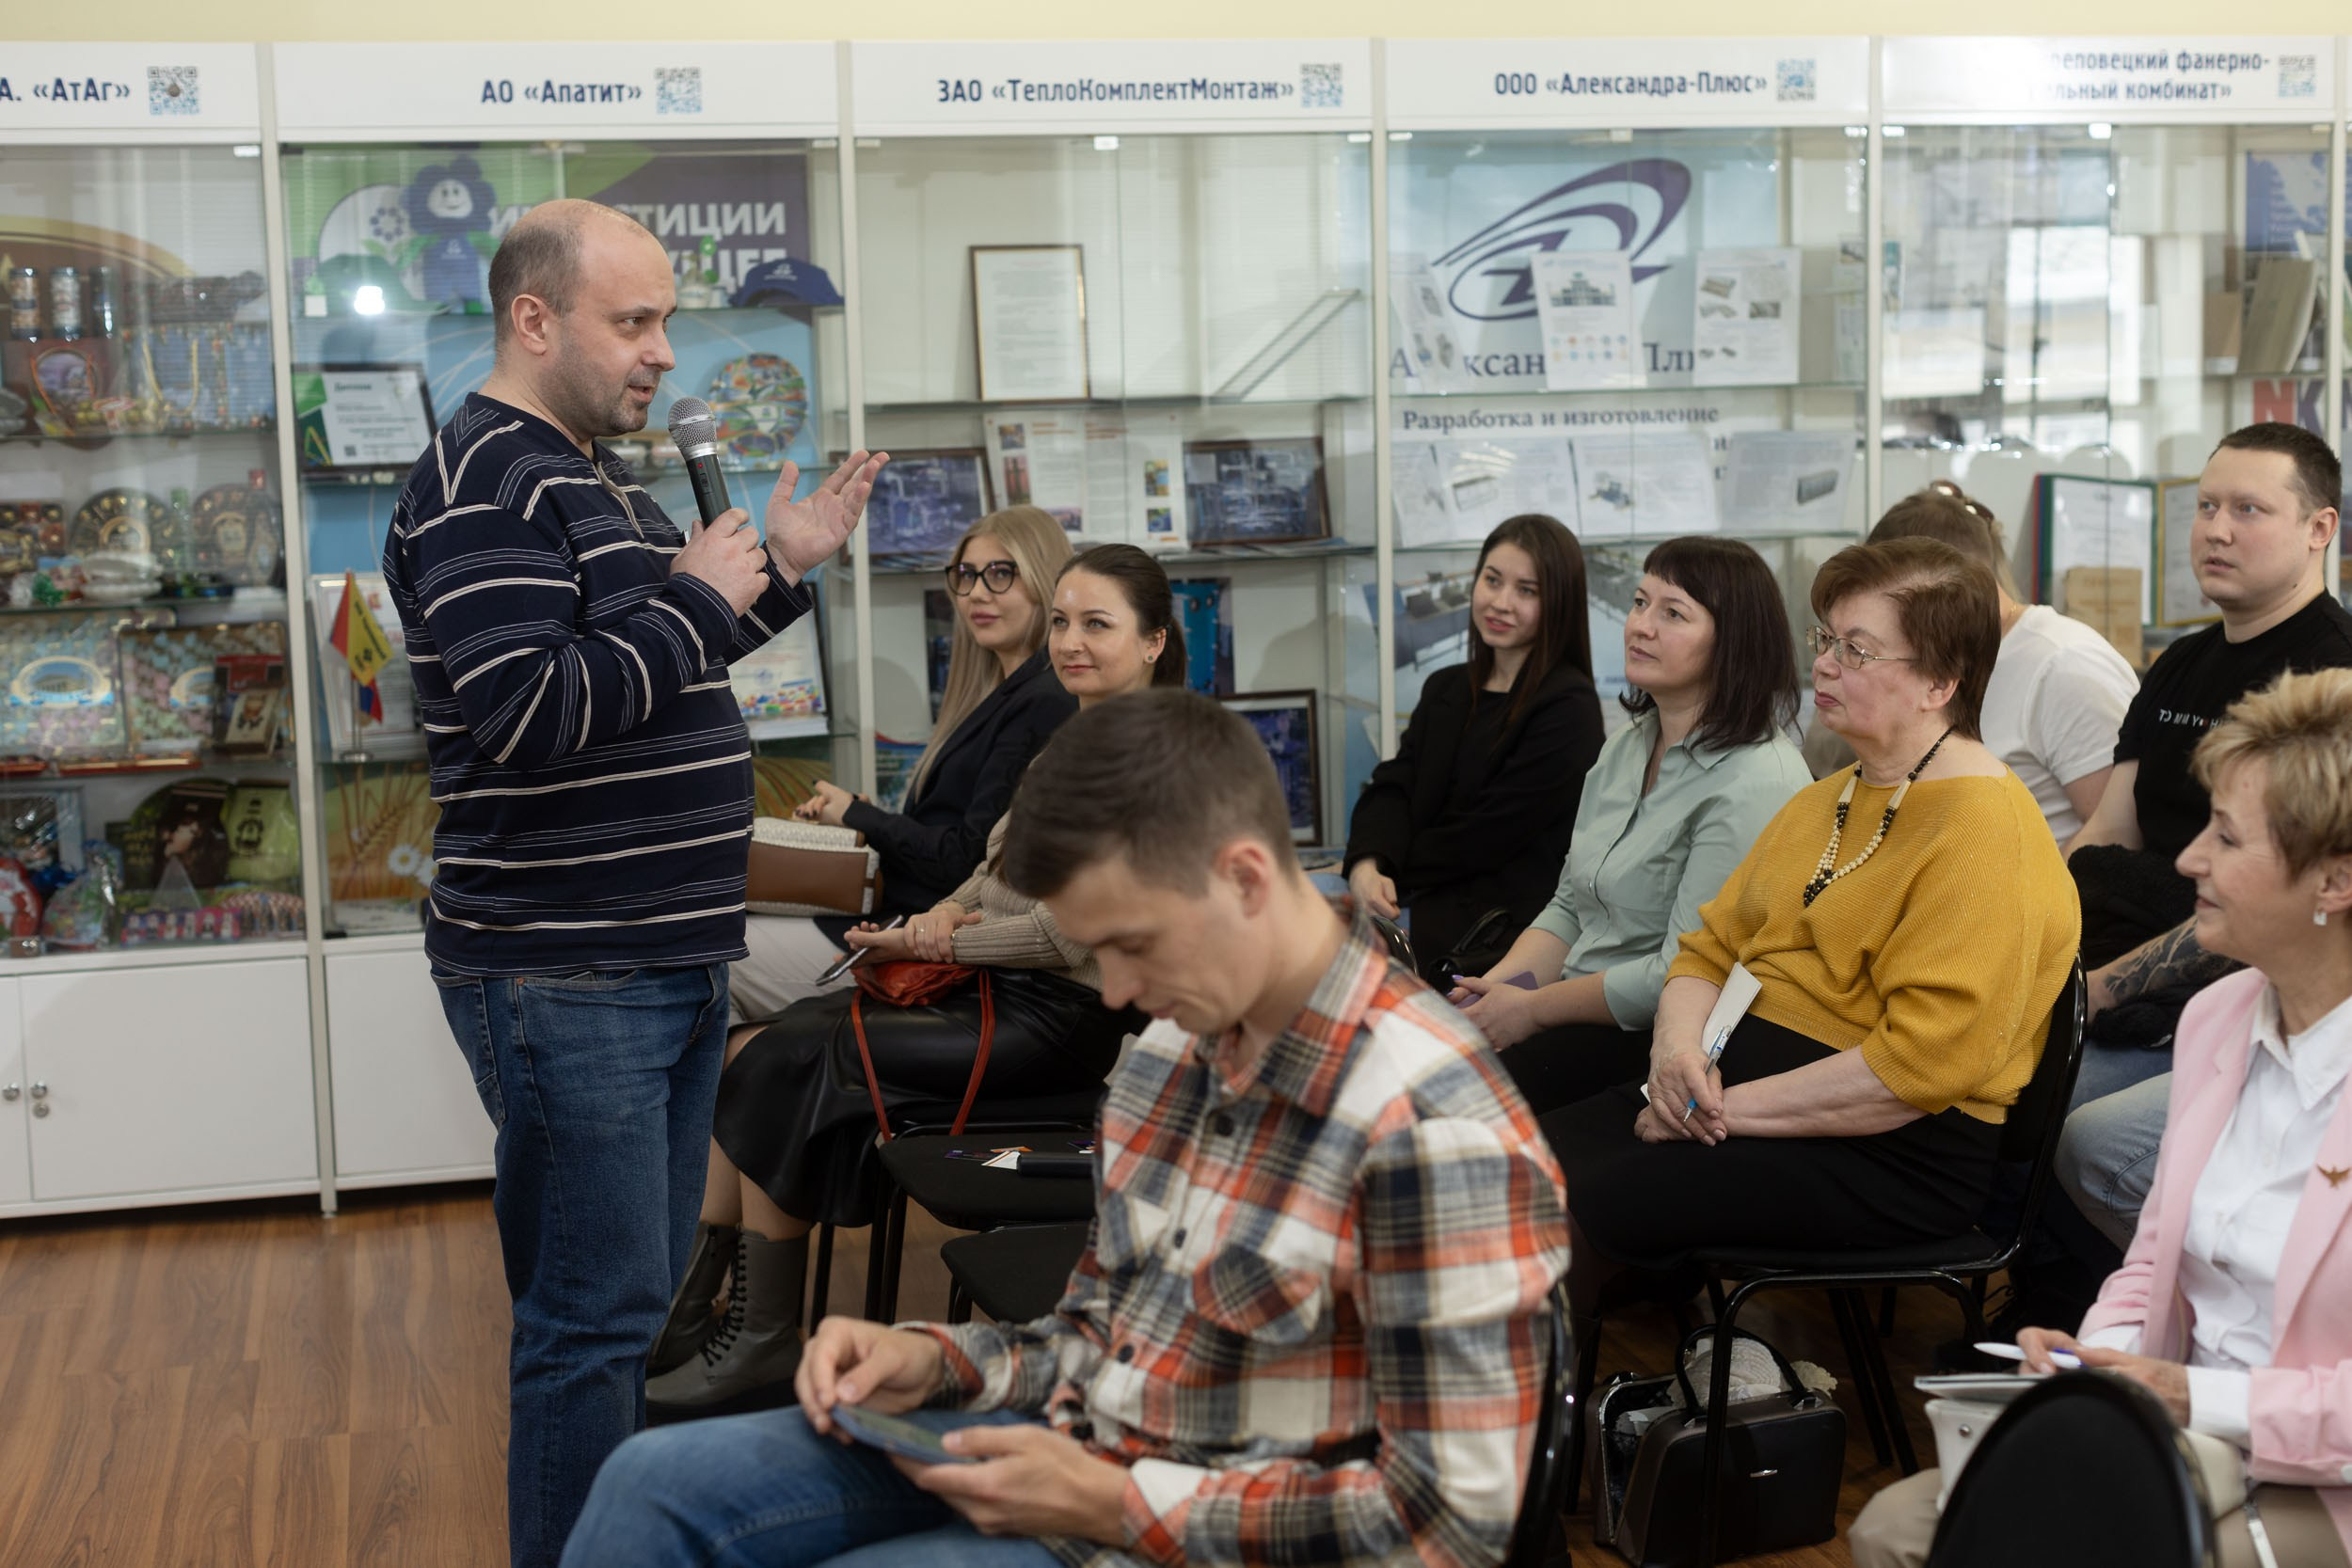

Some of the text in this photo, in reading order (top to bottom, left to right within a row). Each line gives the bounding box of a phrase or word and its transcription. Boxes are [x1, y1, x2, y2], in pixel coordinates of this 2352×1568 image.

[2051, 49, 2269, 72] еповецкий фанерно-
[33, 77, 130, 101] «АтАг»
[482, 80, 642, 103] АО «Апатит»
[938, 78, 1295, 103] ЗАО «ТеплоКомплектМонтаж»
[1495, 72, 1768, 97] ООО «Александра-Плюс»
[2045, 79, 2232, 101] льный комбинат»
[1403, 403, 1720, 435] Разработка и изготовление
